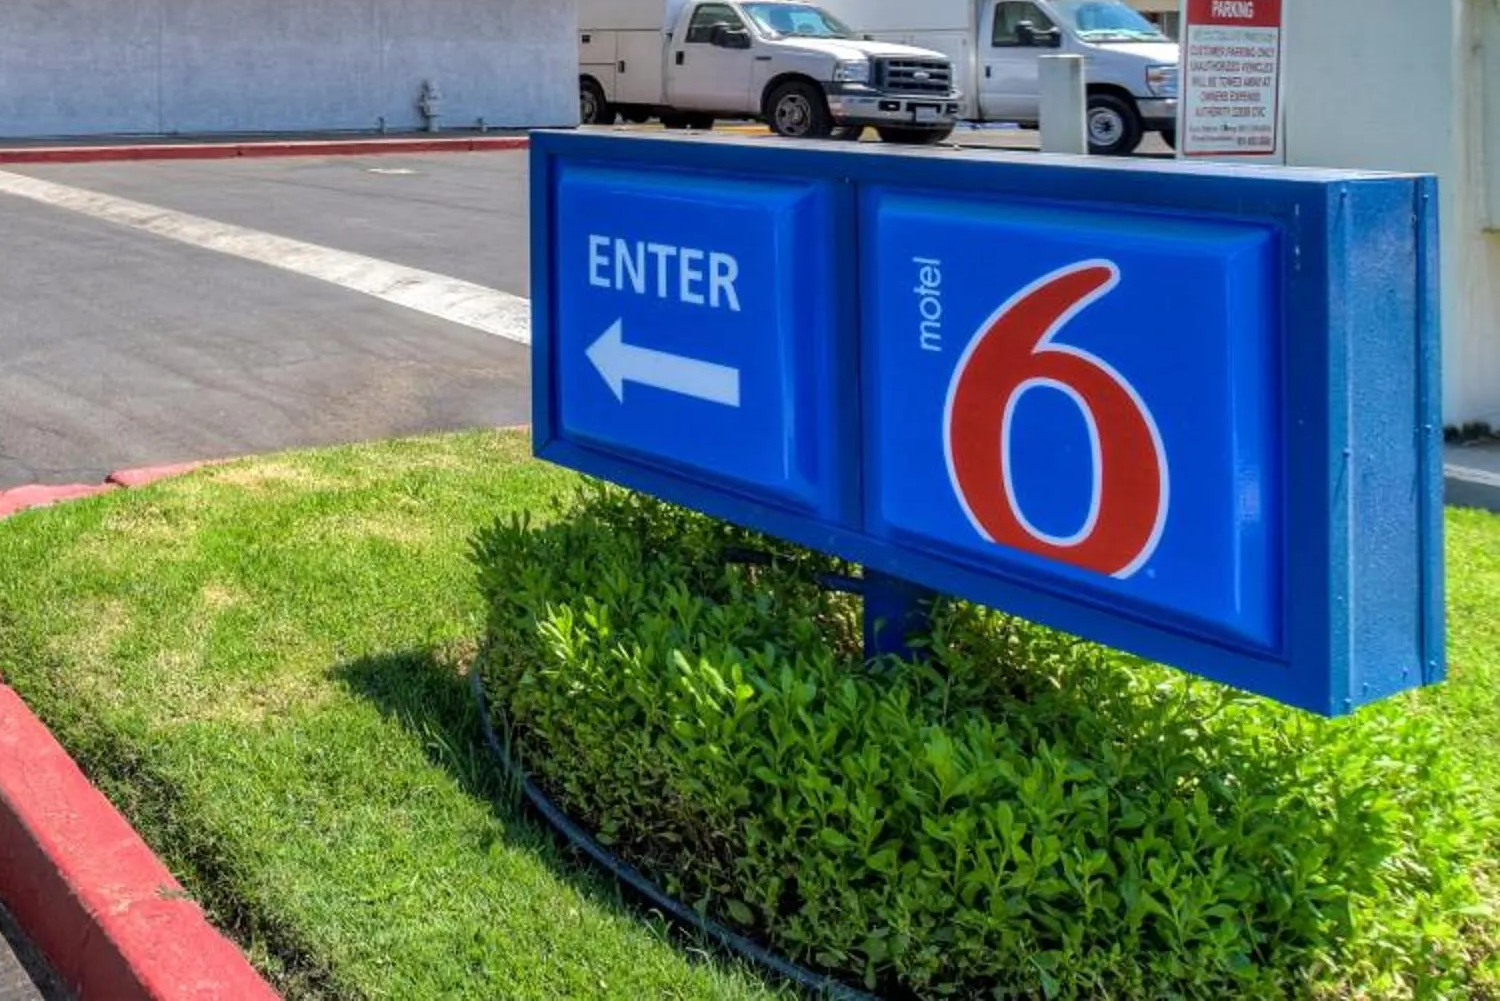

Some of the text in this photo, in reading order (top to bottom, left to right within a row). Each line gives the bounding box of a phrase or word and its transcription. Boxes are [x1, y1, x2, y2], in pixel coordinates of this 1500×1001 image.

[1212, 0, 1253, 18] PARKING
[587, 235, 740, 312] ENTER
[912, 257, 1171, 579] motel 6
